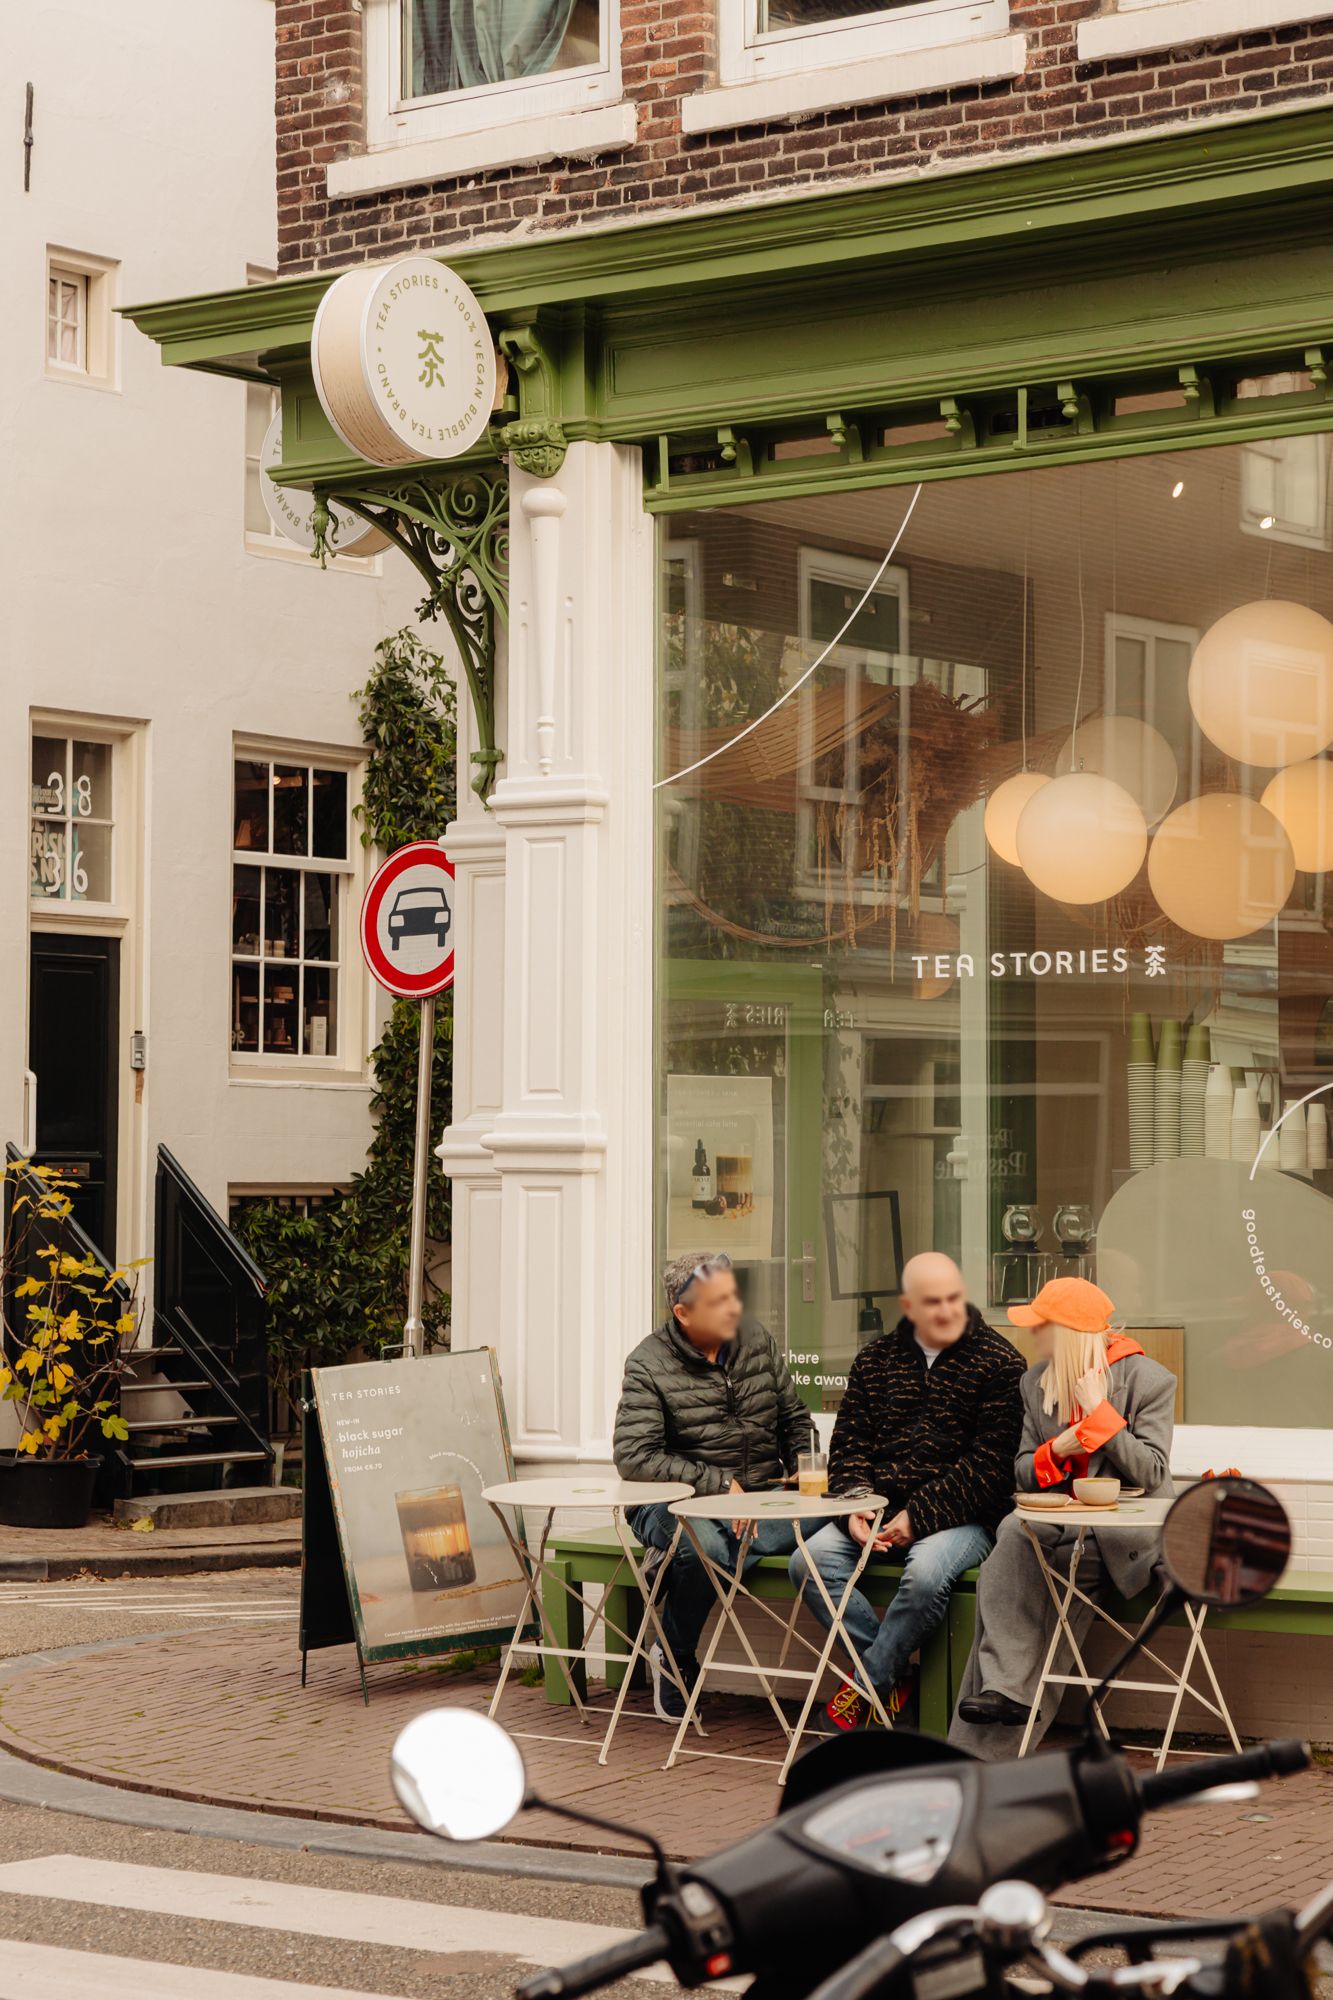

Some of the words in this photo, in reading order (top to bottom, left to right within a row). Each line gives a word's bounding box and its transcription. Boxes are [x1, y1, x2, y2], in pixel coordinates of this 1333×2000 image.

[375, 303, 391, 331] TEA
[389, 274, 439, 301] STORIES
[453, 294, 478, 333] 100%
[416, 328, 446, 389] 茶
[473, 339, 486, 400] VEGAN
[377, 363, 408, 421] BRAND
[410, 418, 433, 440] TEA
[438, 403, 478, 441] BUBBLE
[911, 953, 974, 979] TEA
[990, 947, 1129, 977] STORIES
[789, 1349, 820, 1365] here
[356, 1385, 401, 1399] STORIES
[814, 1373, 849, 1390] away
[371, 1427, 404, 1440] sugar
[342, 1444, 381, 1460] hojicha
